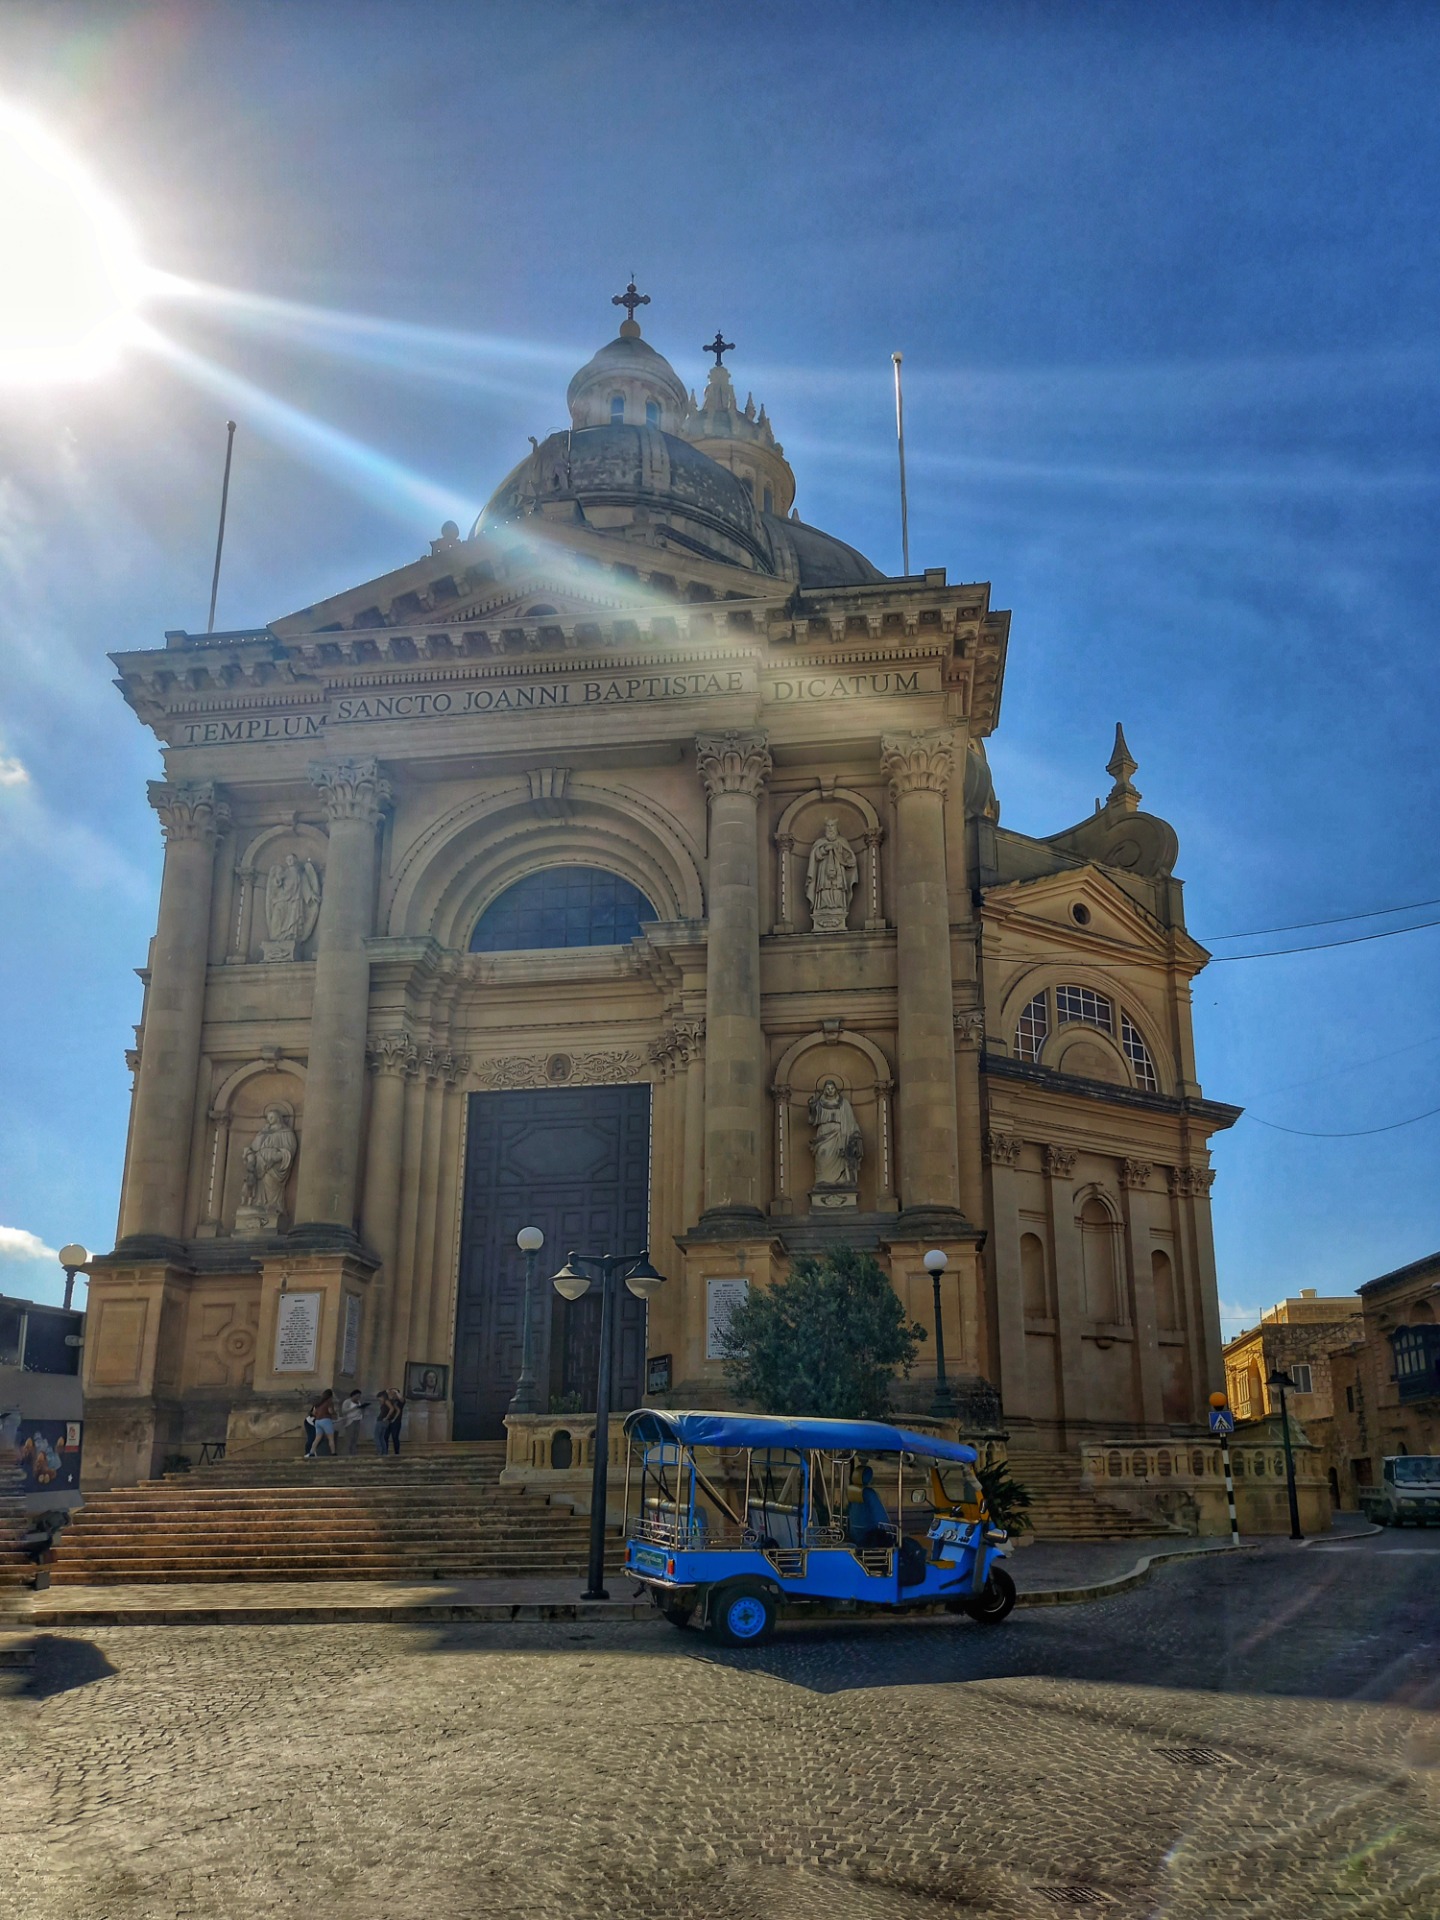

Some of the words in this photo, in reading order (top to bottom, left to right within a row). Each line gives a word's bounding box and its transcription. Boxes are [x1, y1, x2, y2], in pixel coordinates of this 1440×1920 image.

[337, 693, 452, 719] SANCTO
[463, 684, 570, 711] JOANNI
[582, 671, 744, 702] BAPTISTAE
[773, 671, 920, 701] DICATUM
